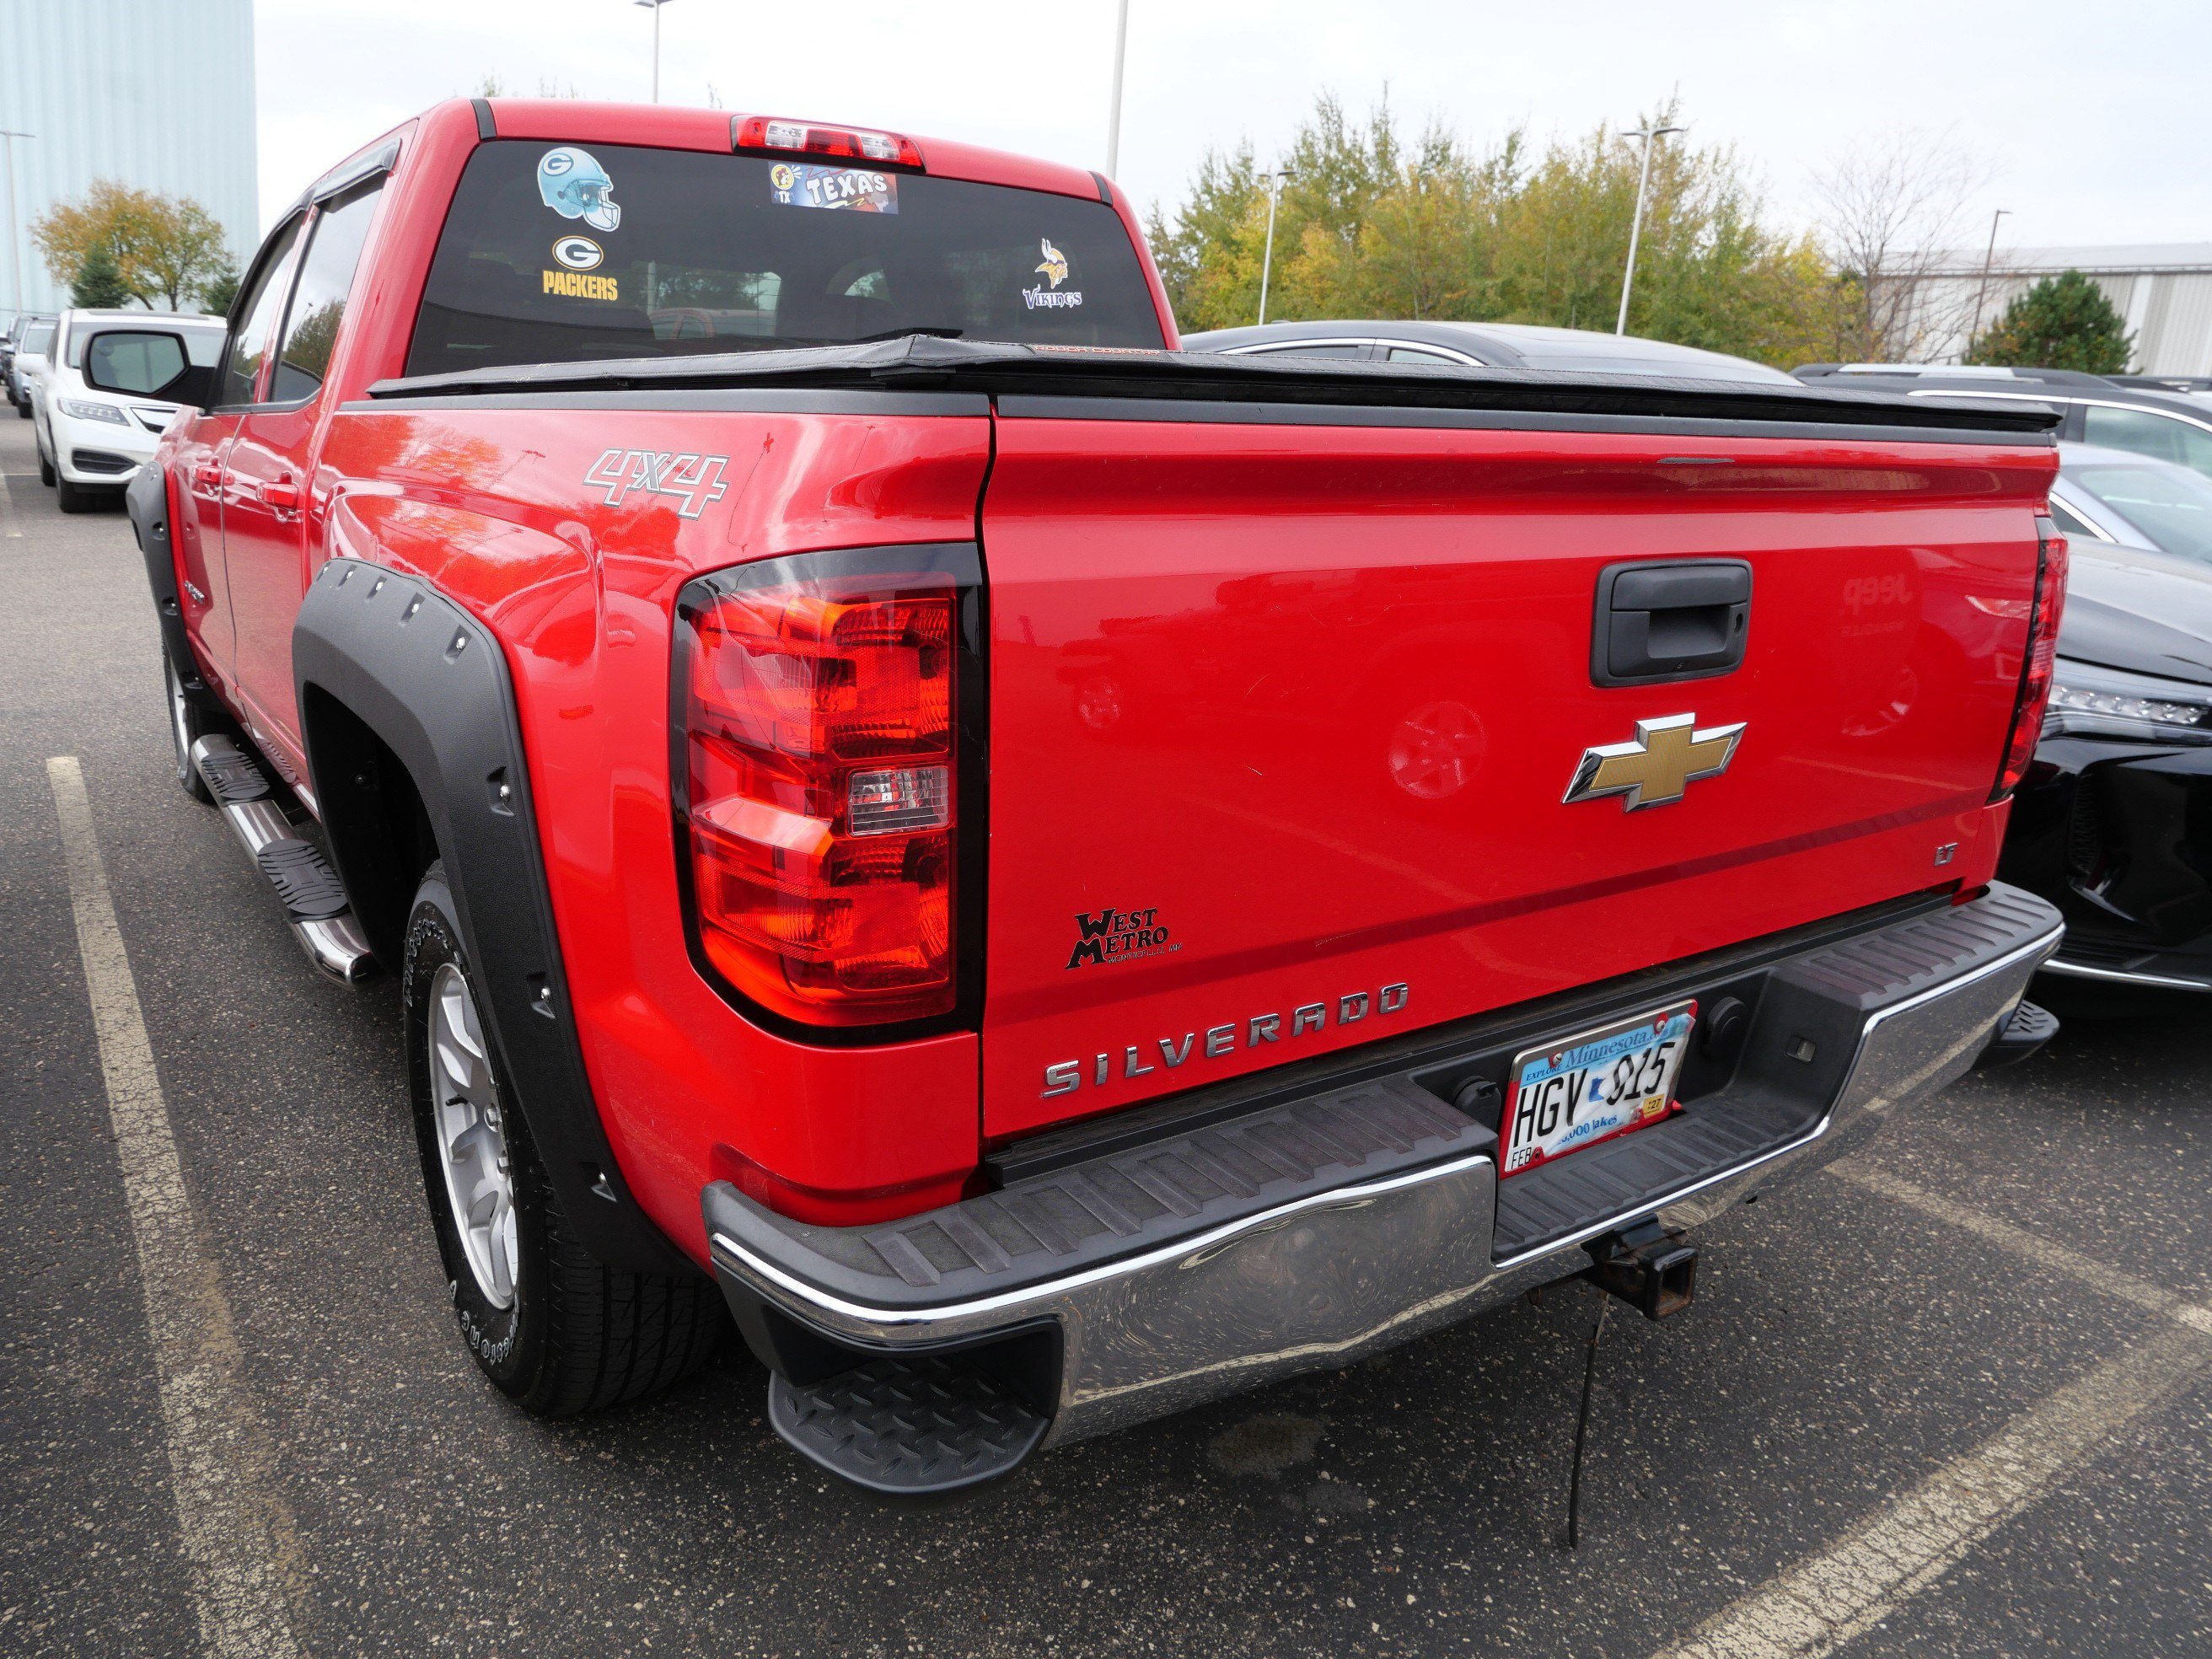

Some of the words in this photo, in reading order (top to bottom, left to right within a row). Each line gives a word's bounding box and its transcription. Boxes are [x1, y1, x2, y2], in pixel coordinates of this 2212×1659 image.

[778, 191, 792, 203] TX
[806, 174, 888, 204] TEXAS
[542, 270, 618, 301] PACKERS
[1092, 347, 1161, 356] COUNTRY
[1934, 842, 1958, 867] LT
[1039, 982, 1409, 1098] SILVERADO
[1513, 1068, 1588, 1147] HGV
[1592, 1114, 1618, 1130] lakes
[1511, 1146, 1533, 1169] FEB
